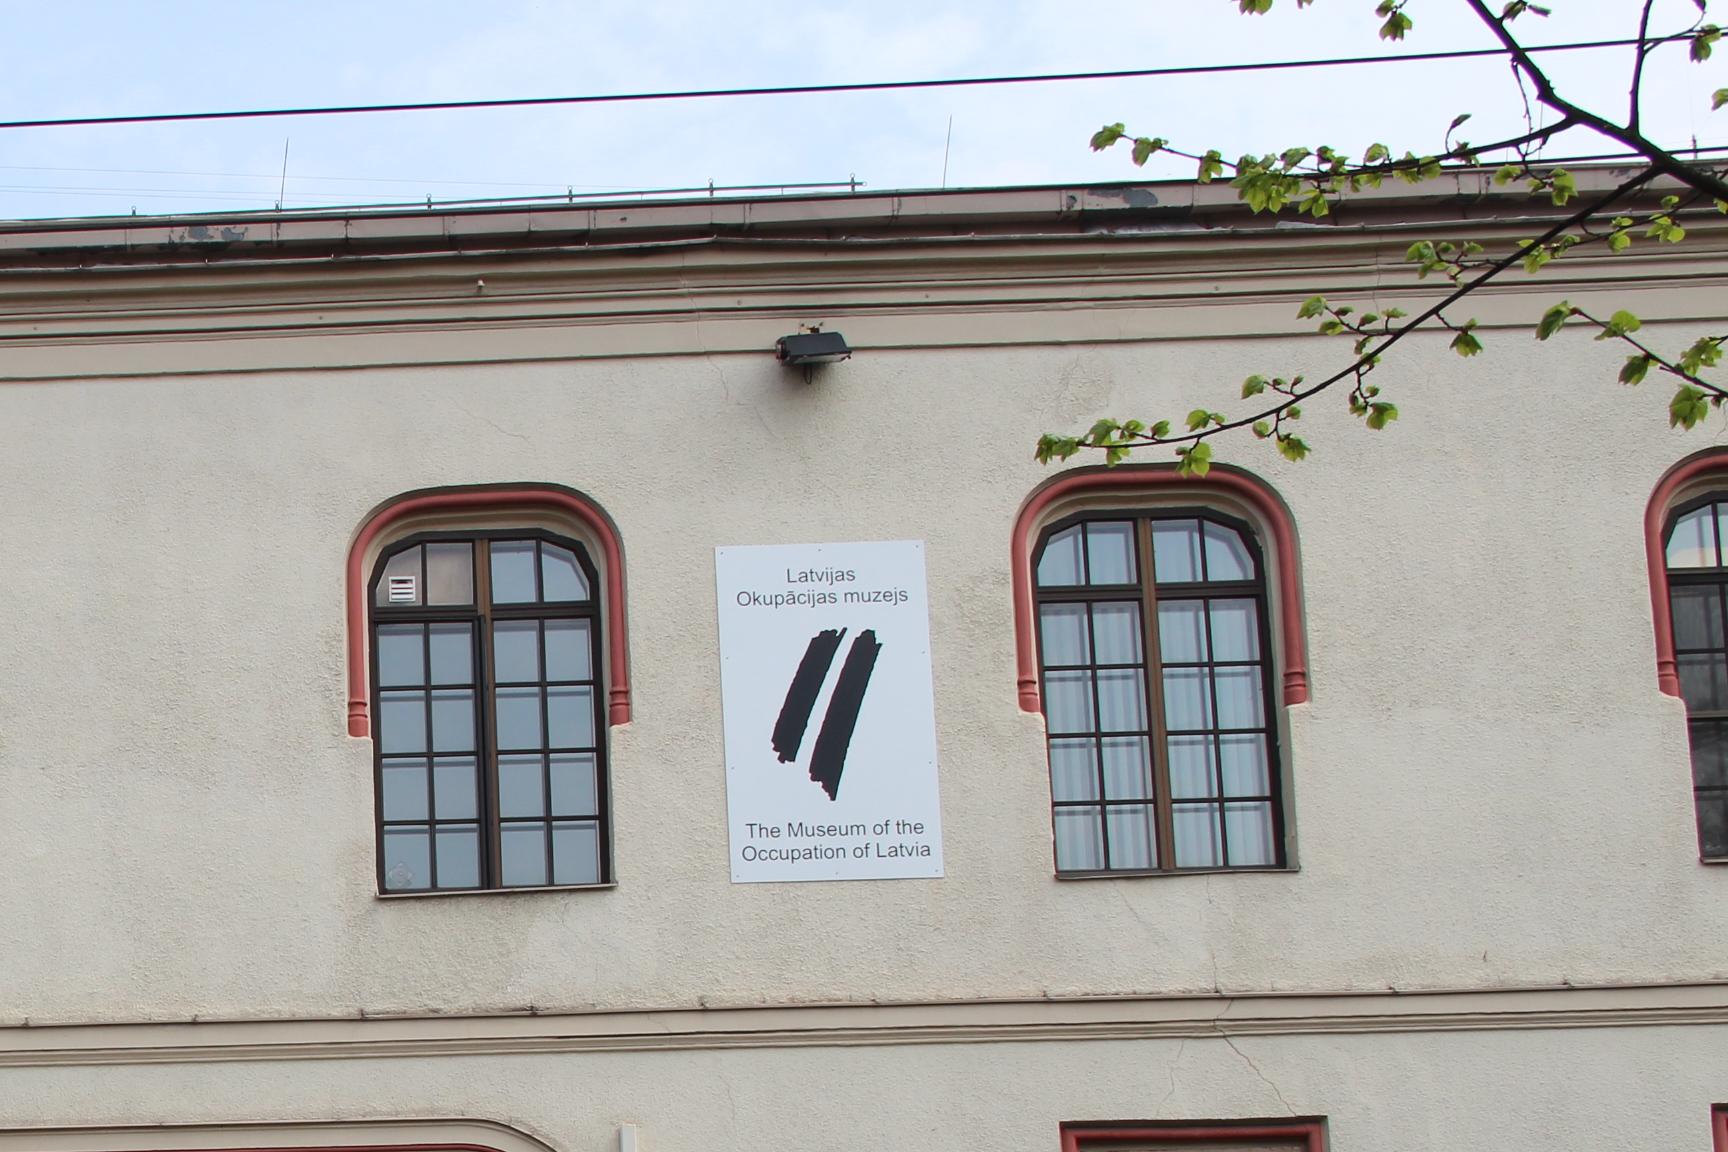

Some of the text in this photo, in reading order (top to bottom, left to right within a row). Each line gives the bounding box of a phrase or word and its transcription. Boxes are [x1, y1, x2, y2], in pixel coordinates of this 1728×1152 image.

[787, 568, 856, 586] Latvijas
[736, 589, 908, 608] Okupācijas muzejs
[746, 820, 924, 838] The Museum of the
[742, 843, 931, 864] Occupation of Latvia
